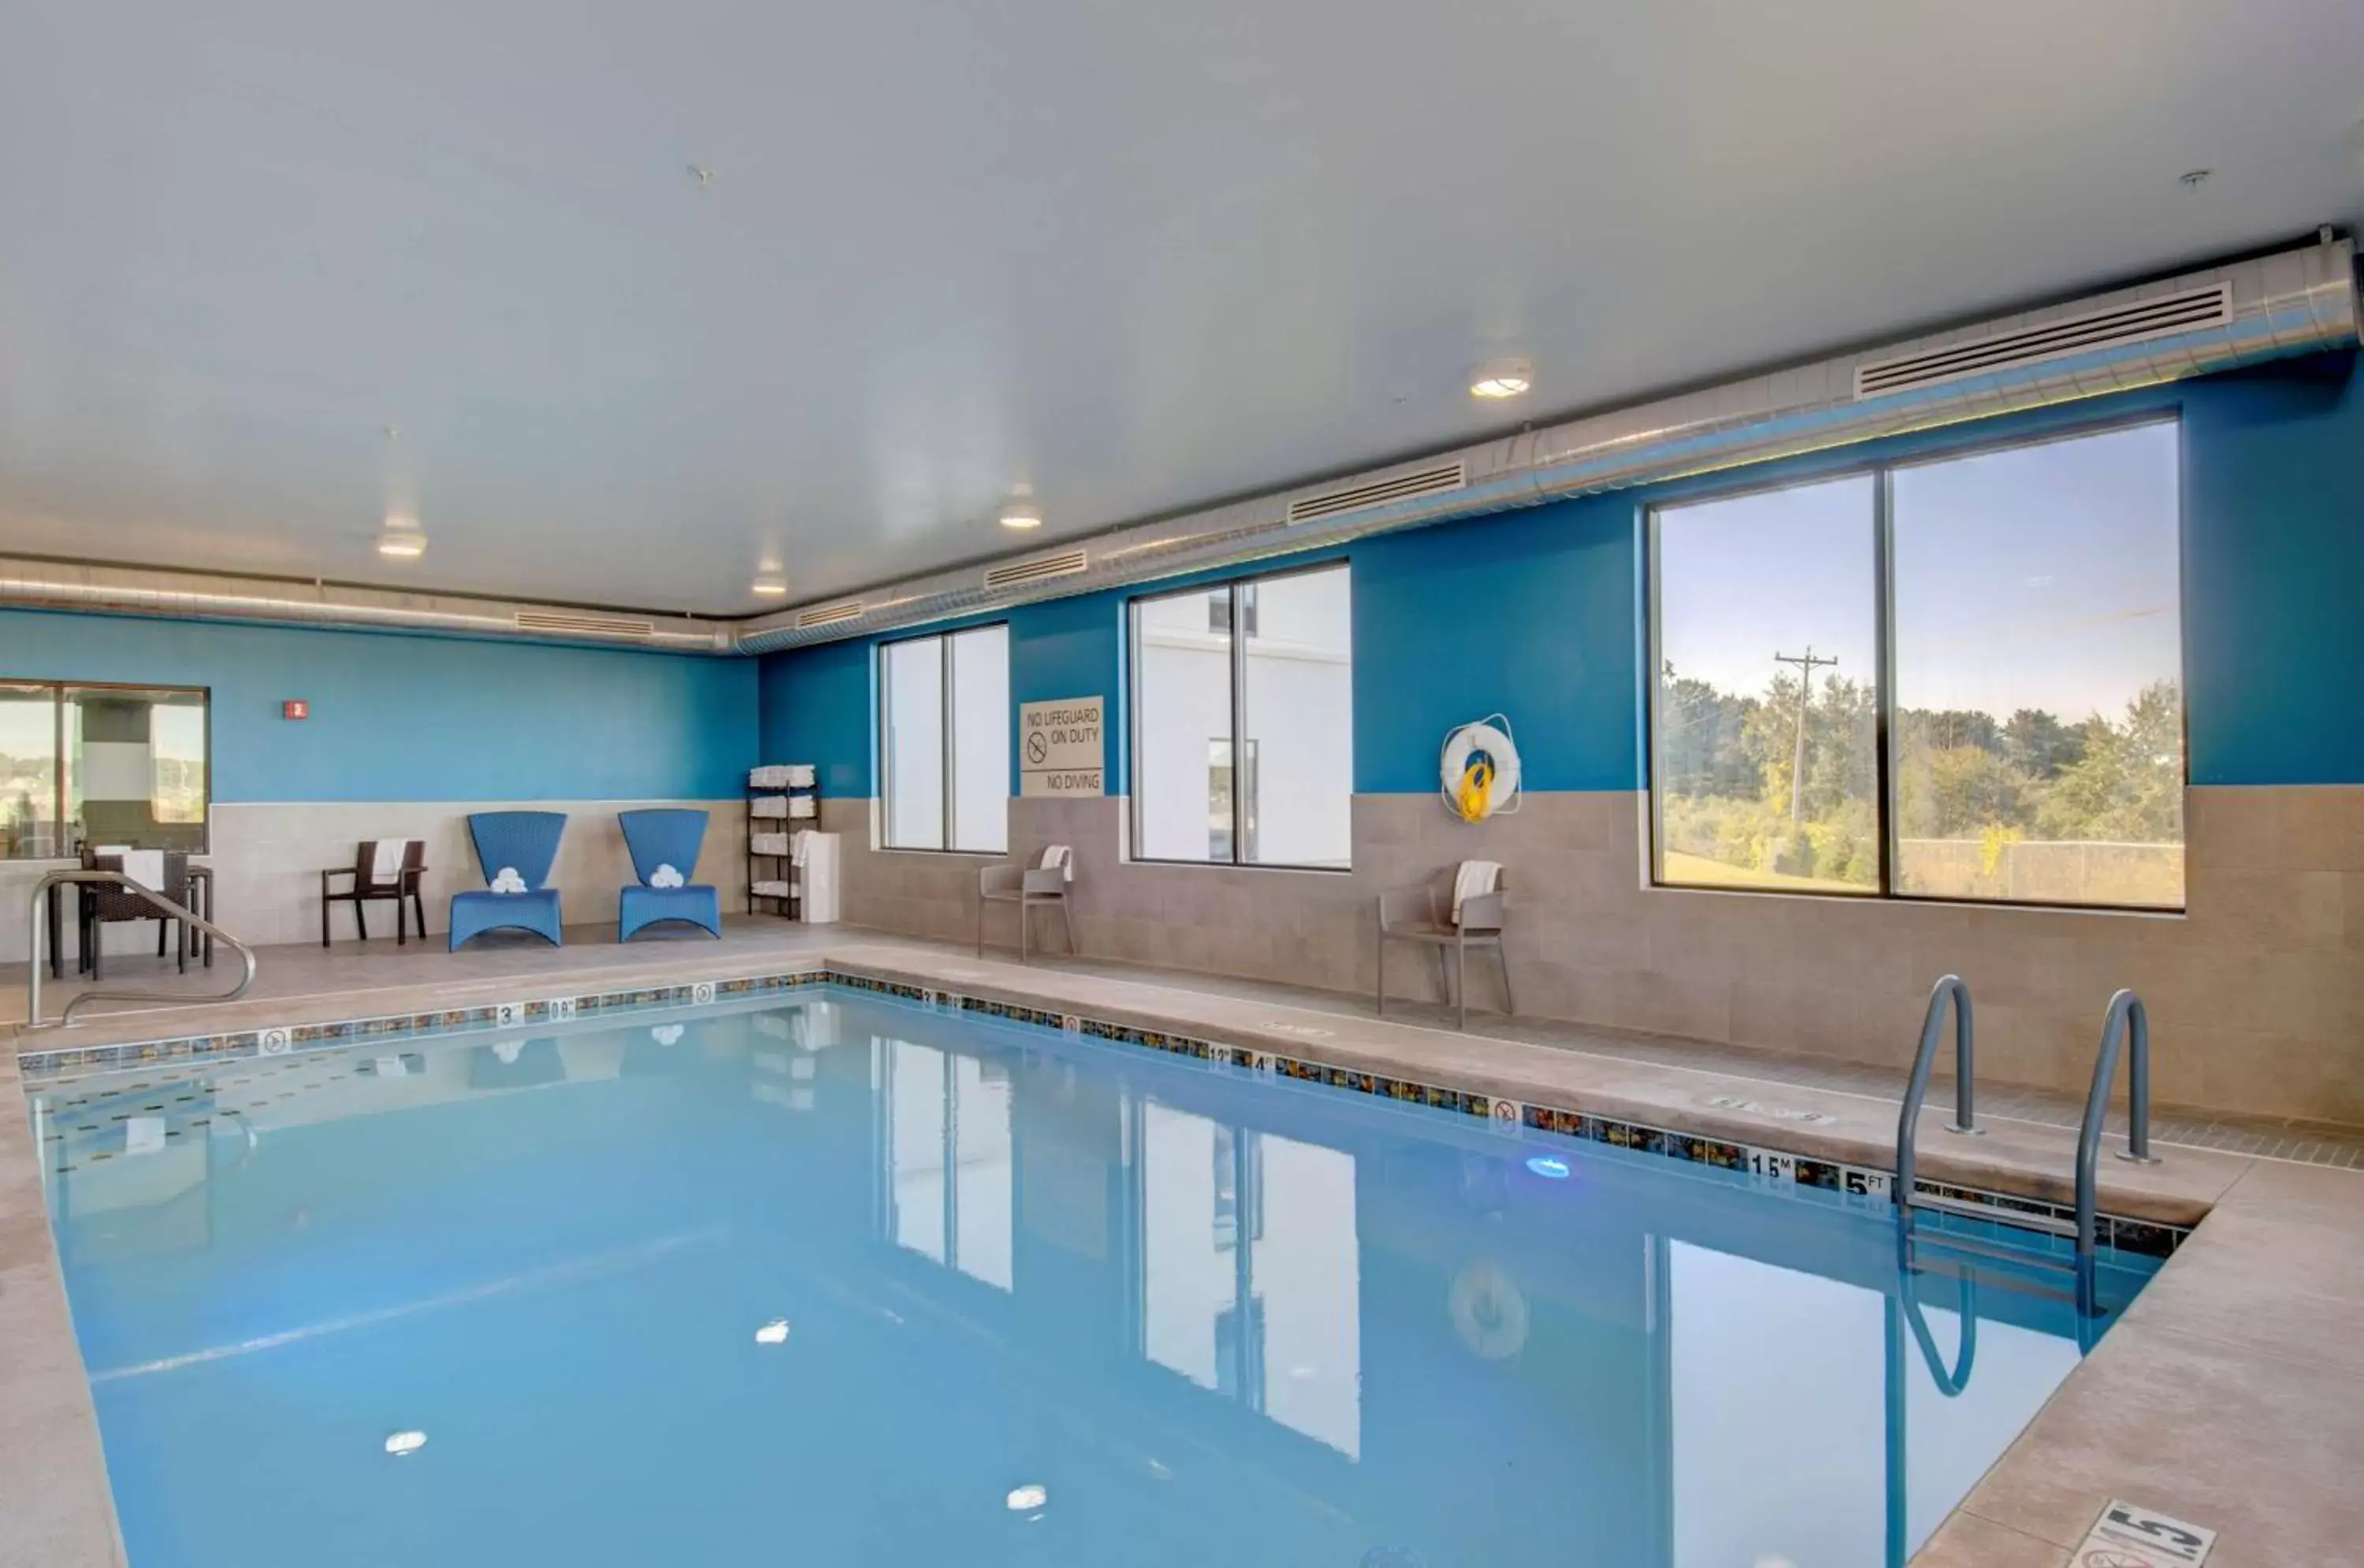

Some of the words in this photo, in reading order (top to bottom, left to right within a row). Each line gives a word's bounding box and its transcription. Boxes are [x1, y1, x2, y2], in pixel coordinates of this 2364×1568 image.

[1028, 712, 1043, 726] NO
[1044, 708, 1099, 726] LIFEGUARD
[1051, 730, 1067, 745] ON
[1069, 726, 1099, 743] DUTY
[1047, 775, 1062, 790] NO
[1065, 774, 1100, 789] DIVING
